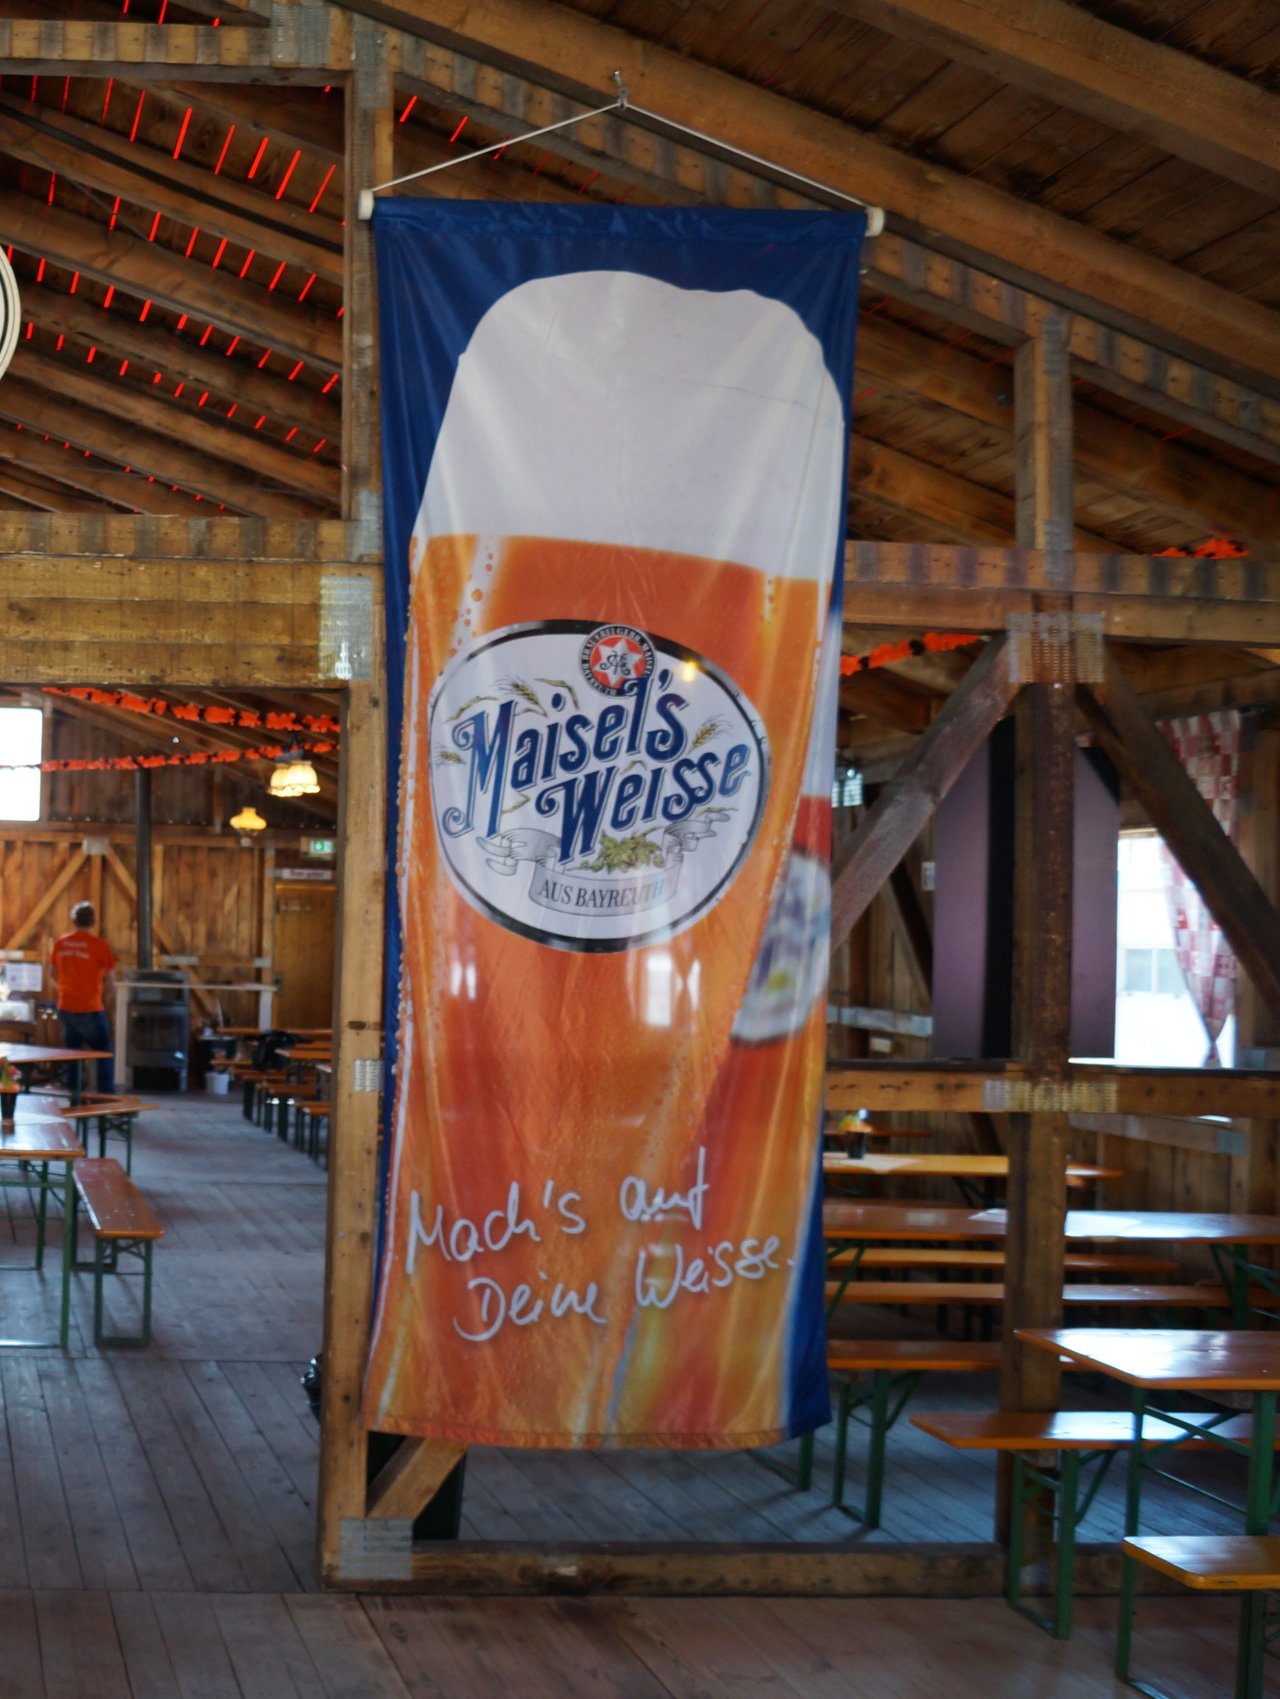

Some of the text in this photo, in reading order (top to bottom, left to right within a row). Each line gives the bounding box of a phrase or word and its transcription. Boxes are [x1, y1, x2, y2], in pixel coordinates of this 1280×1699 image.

[441, 668, 691, 840] Maisel's
[535, 743, 754, 865] Weisse
[539, 878, 665, 908] AUS BAYREUTH
[406, 1145, 709, 1275] Mach's auf
[451, 1271, 609, 1342] Deine
